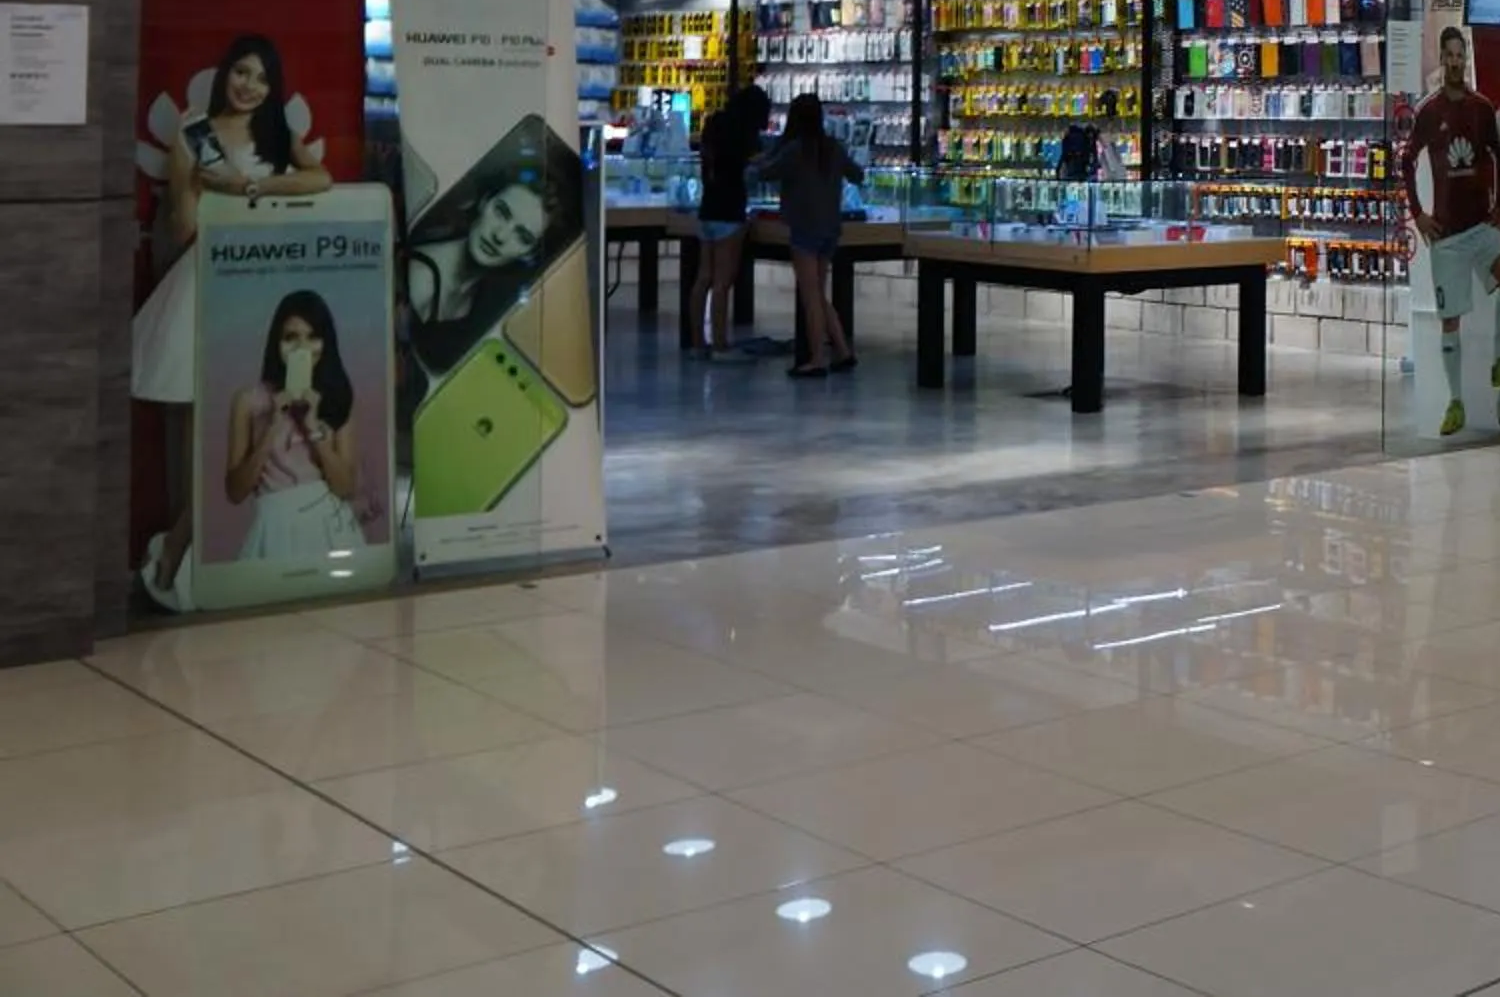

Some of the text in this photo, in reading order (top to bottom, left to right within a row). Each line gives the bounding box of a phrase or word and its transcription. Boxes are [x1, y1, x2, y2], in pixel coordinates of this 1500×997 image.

[406, 33, 466, 44] HUAWEI
[211, 235, 381, 262] HUAWEI P9 lite
